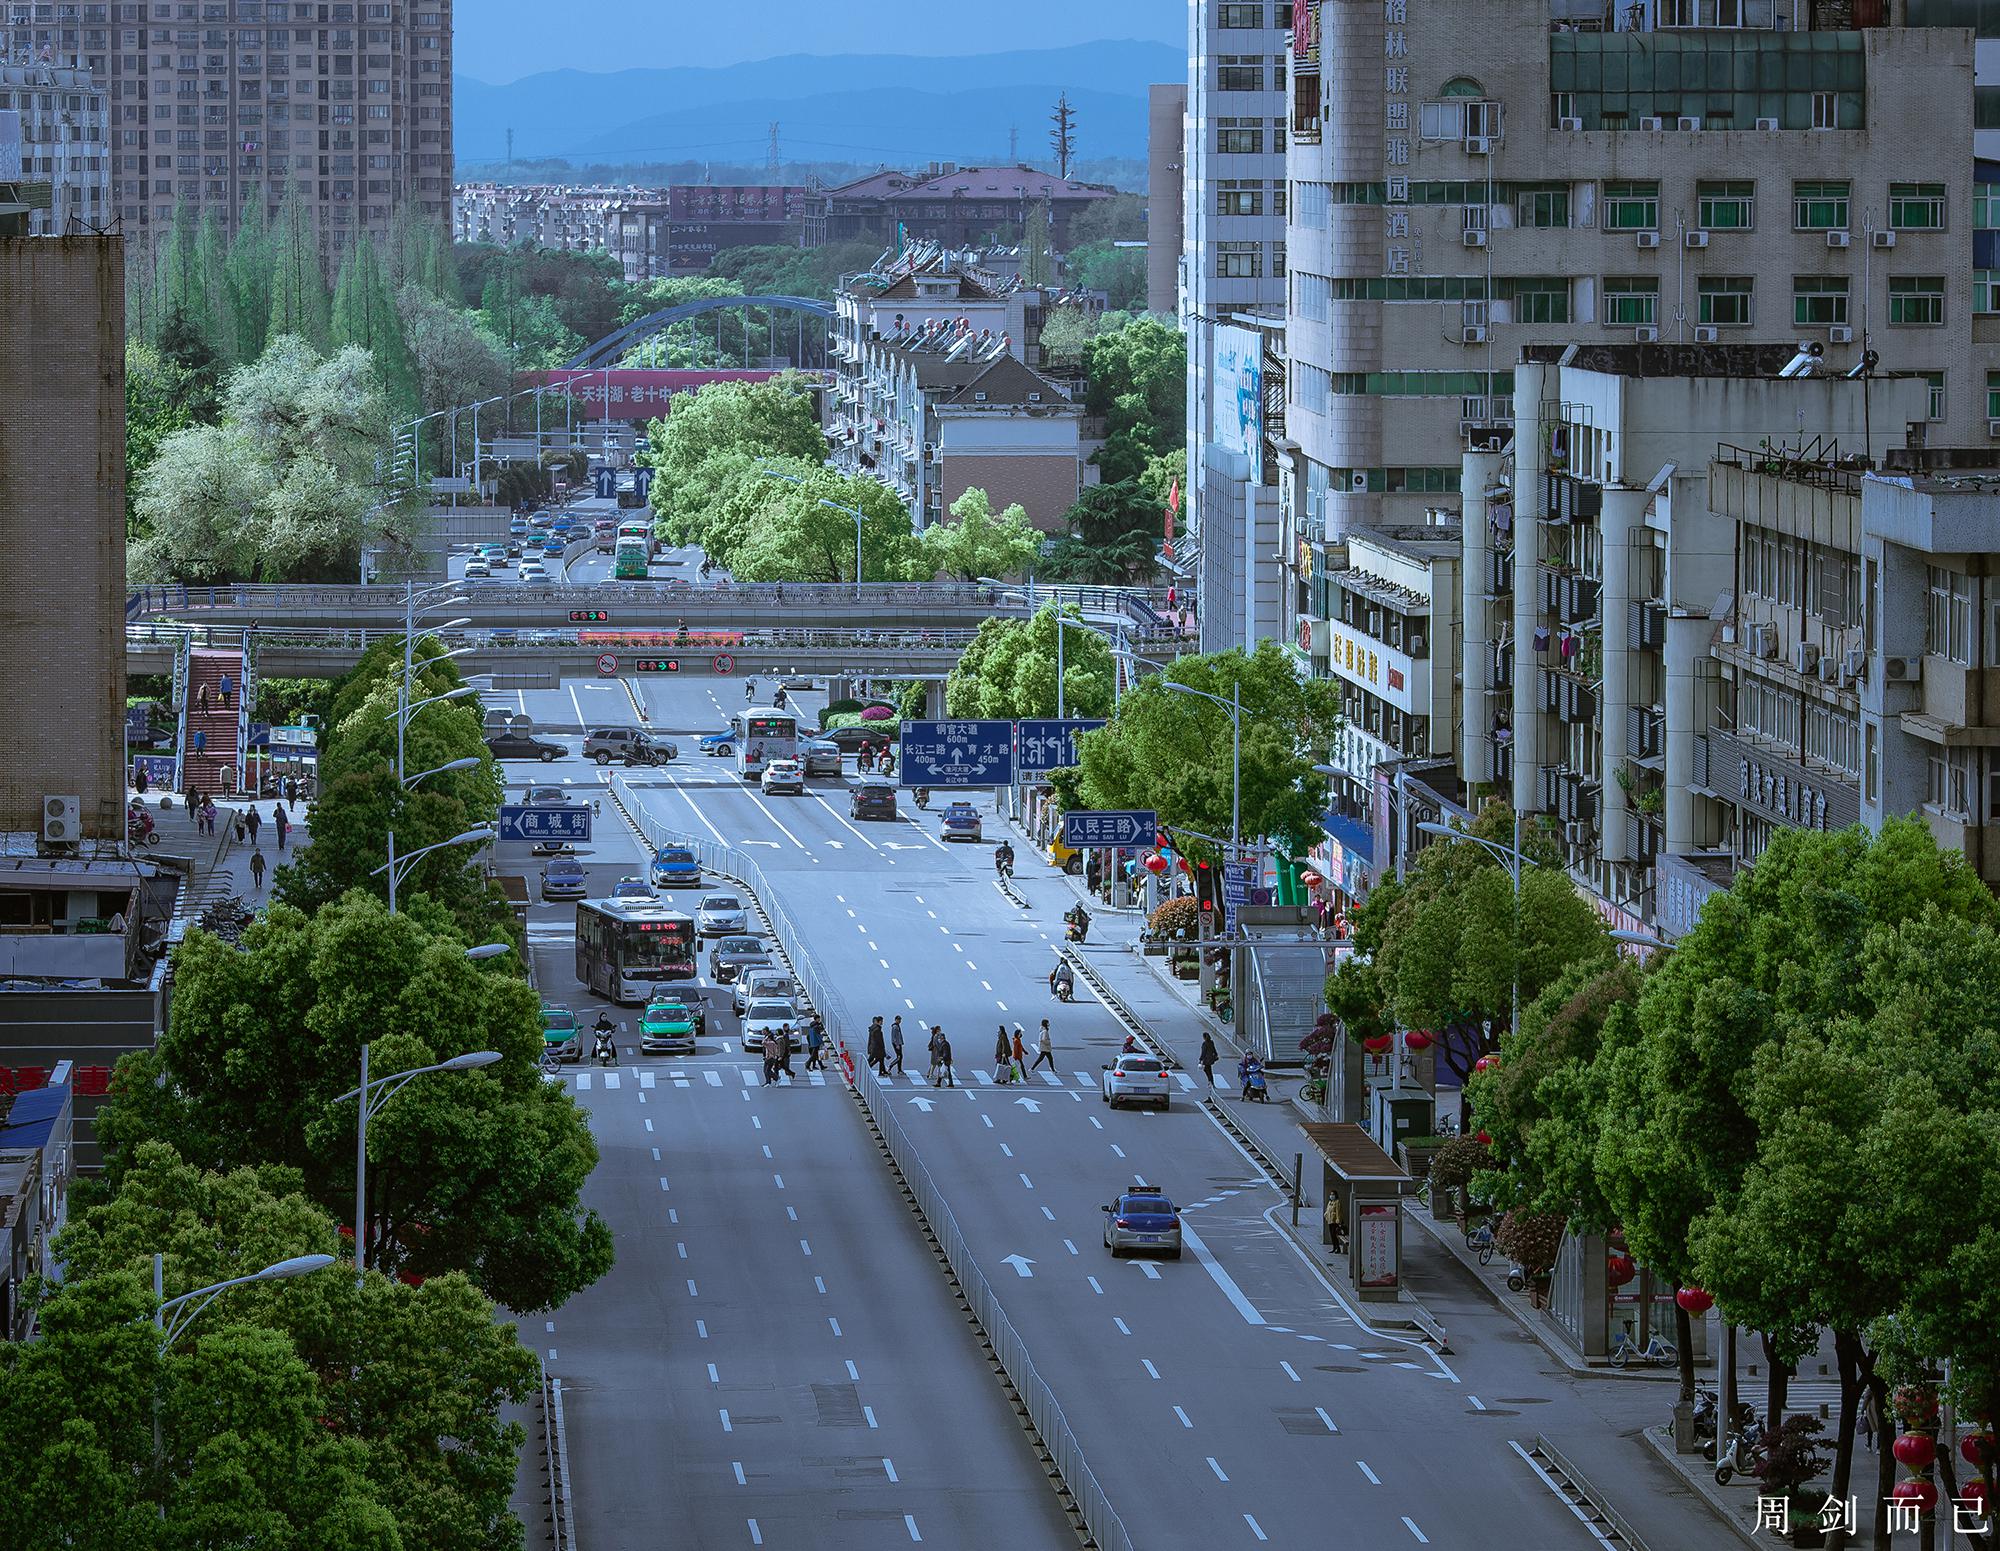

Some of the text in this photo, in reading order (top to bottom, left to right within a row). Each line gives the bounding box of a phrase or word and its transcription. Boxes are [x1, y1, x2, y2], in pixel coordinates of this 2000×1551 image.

[1385, 0, 1409, 273] 格林联盟雅园酒店
[936, 723, 979, 736] 铜官大道
[947, 735, 968, 744] 600m
[904, 743, 946, 755] 长江二路
[967, 743, 1009, 755] 育才路
[914, 755, 936, 764] 400m
[978, 755, 999, 764] 450m
[502, 815, 513, 827] 南
[525, 813, 586, 829] 商城街
[1070, 819, 1131, 834] 人民三路
[1143, 821, 1154, 831] 北
